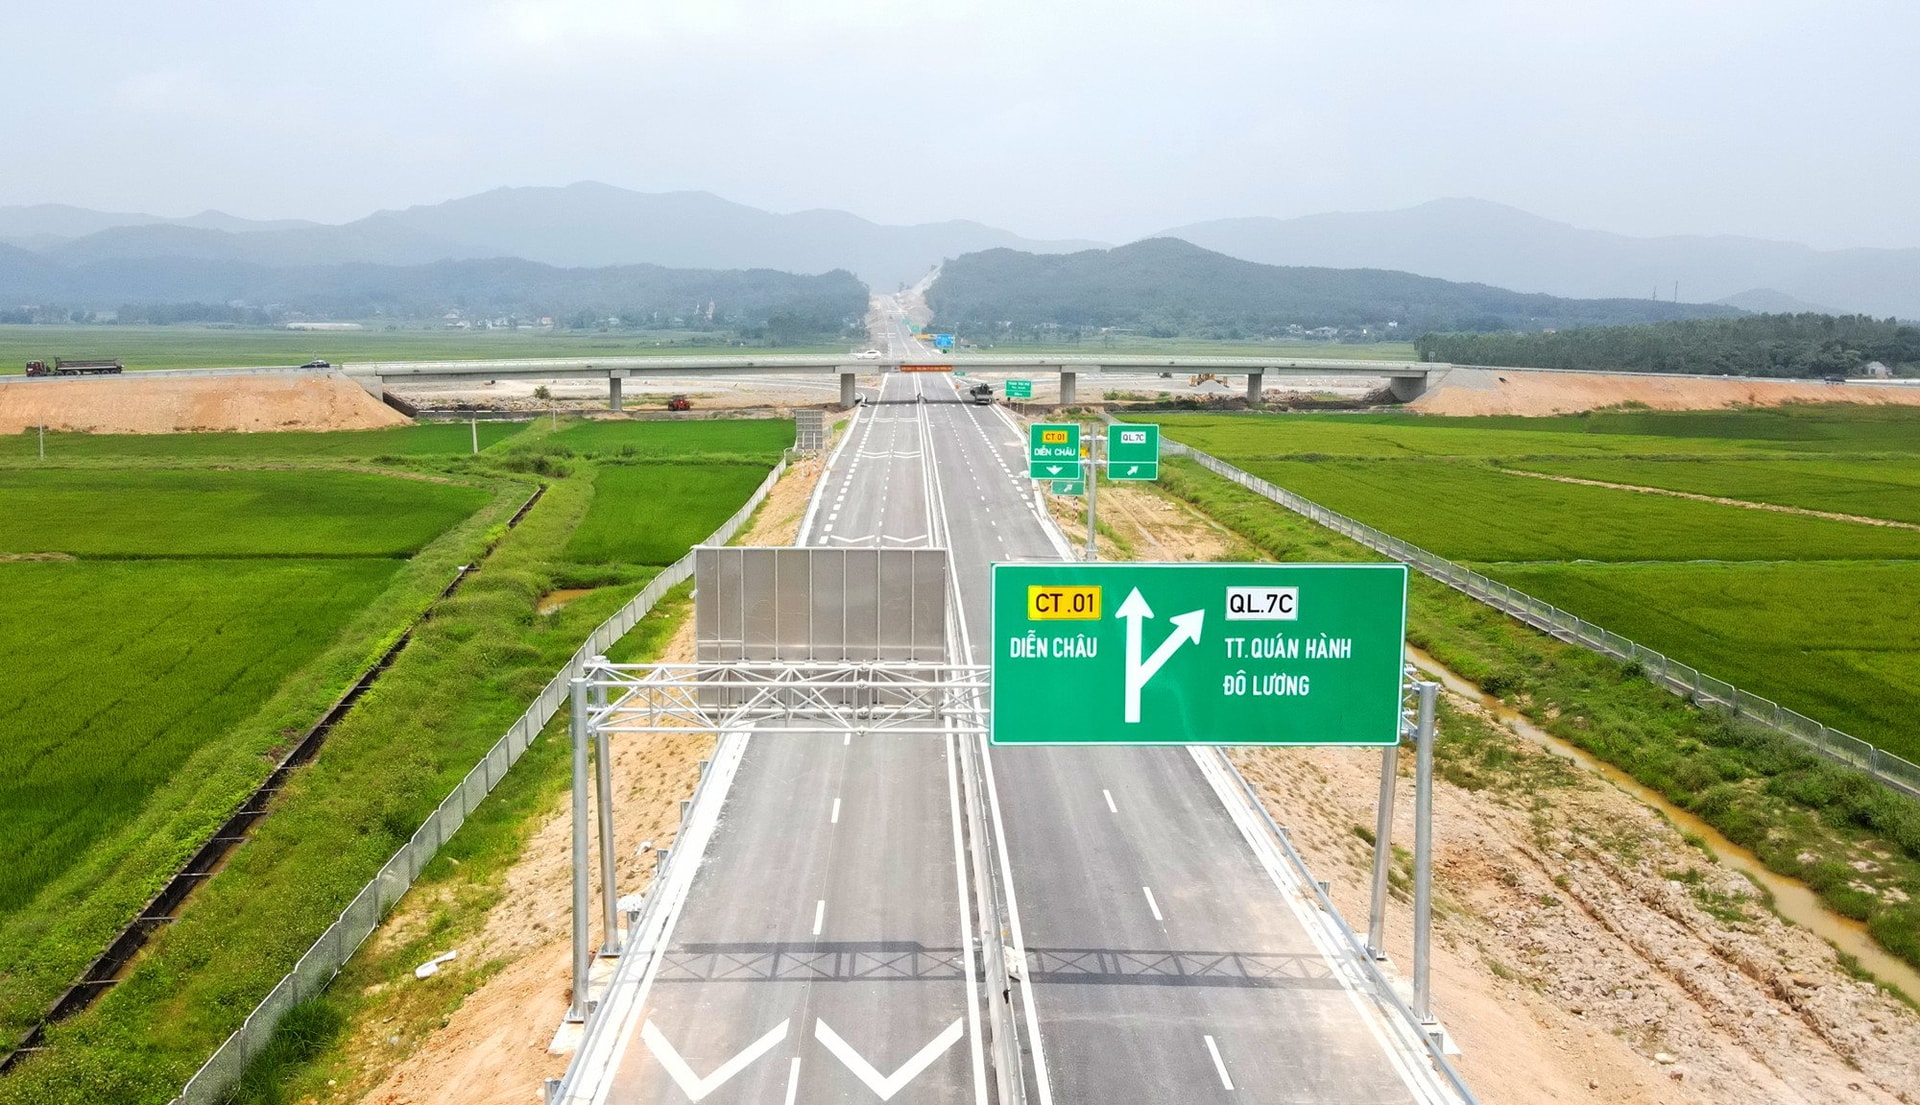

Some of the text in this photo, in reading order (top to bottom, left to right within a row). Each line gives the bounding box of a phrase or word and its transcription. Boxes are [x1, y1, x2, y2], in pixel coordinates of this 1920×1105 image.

[1230, 593, 1293, 613] QL.7C
[1010, 629, 1098, 658] DIỄN CHÂU
[1224, 632, 1352, 659] TT.QUÁN HÀNH
[1223, 669, 1310, 696] ĐÔ LƯƠNG
